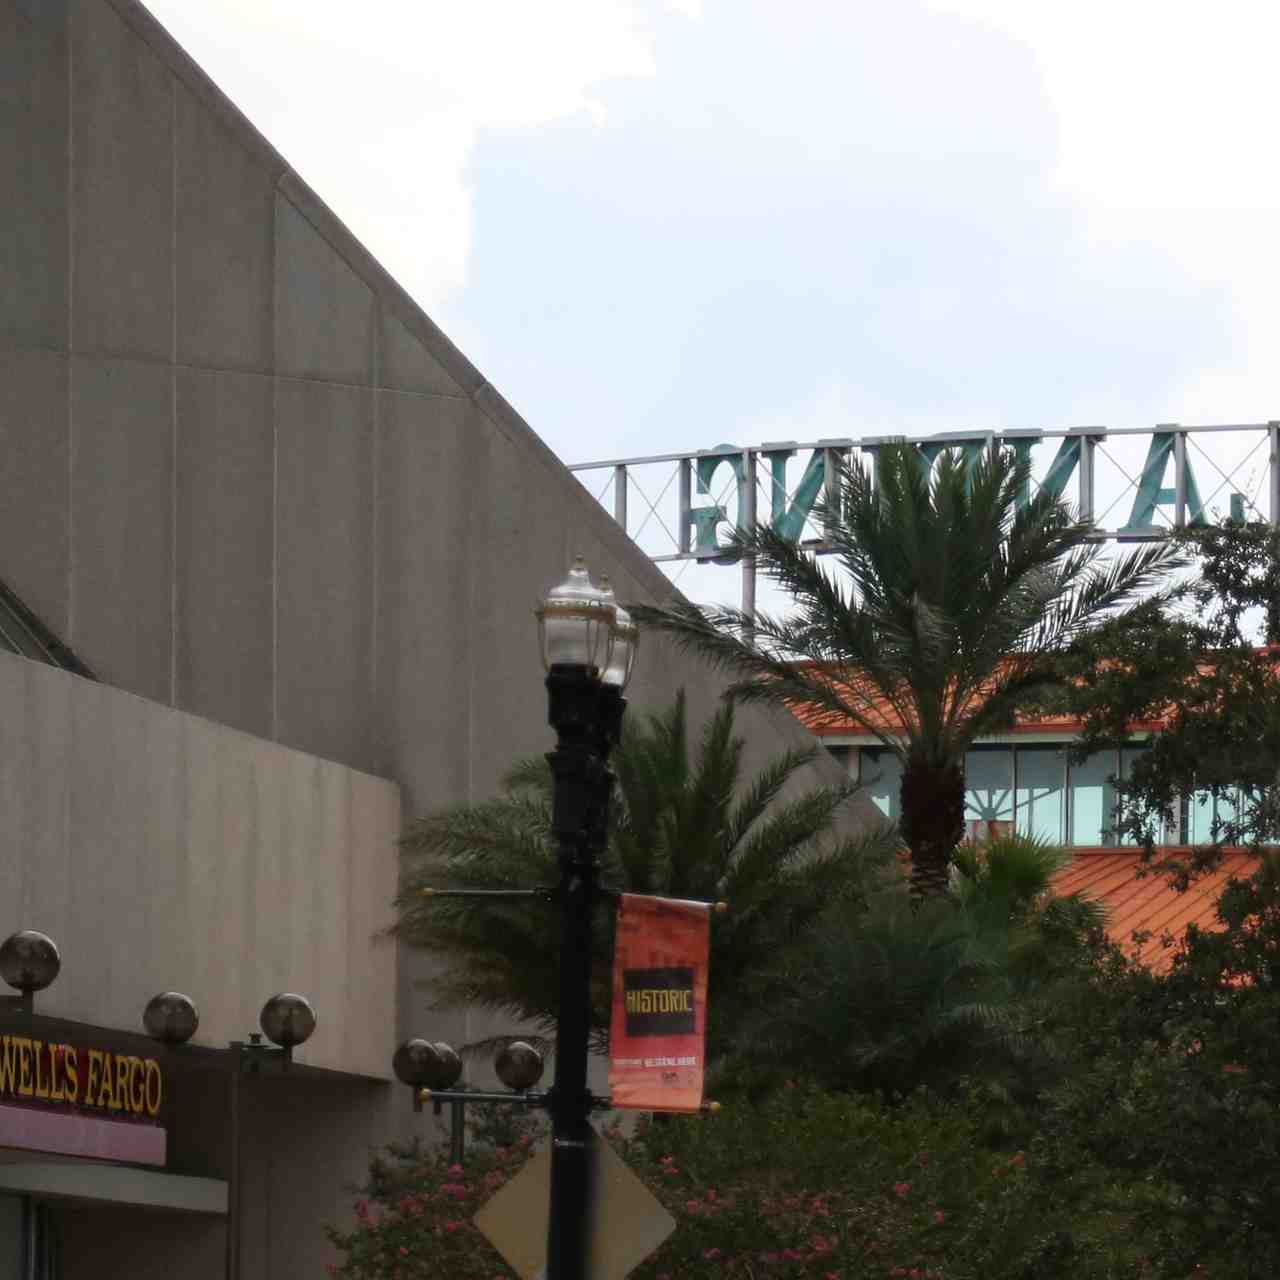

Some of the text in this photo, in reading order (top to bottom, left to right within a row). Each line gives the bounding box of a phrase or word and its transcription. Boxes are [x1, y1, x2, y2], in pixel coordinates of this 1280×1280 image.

[625, 989, 692, 1014] HISTORIC
[0, 1035, 161, 1117] WELLS FARGO
